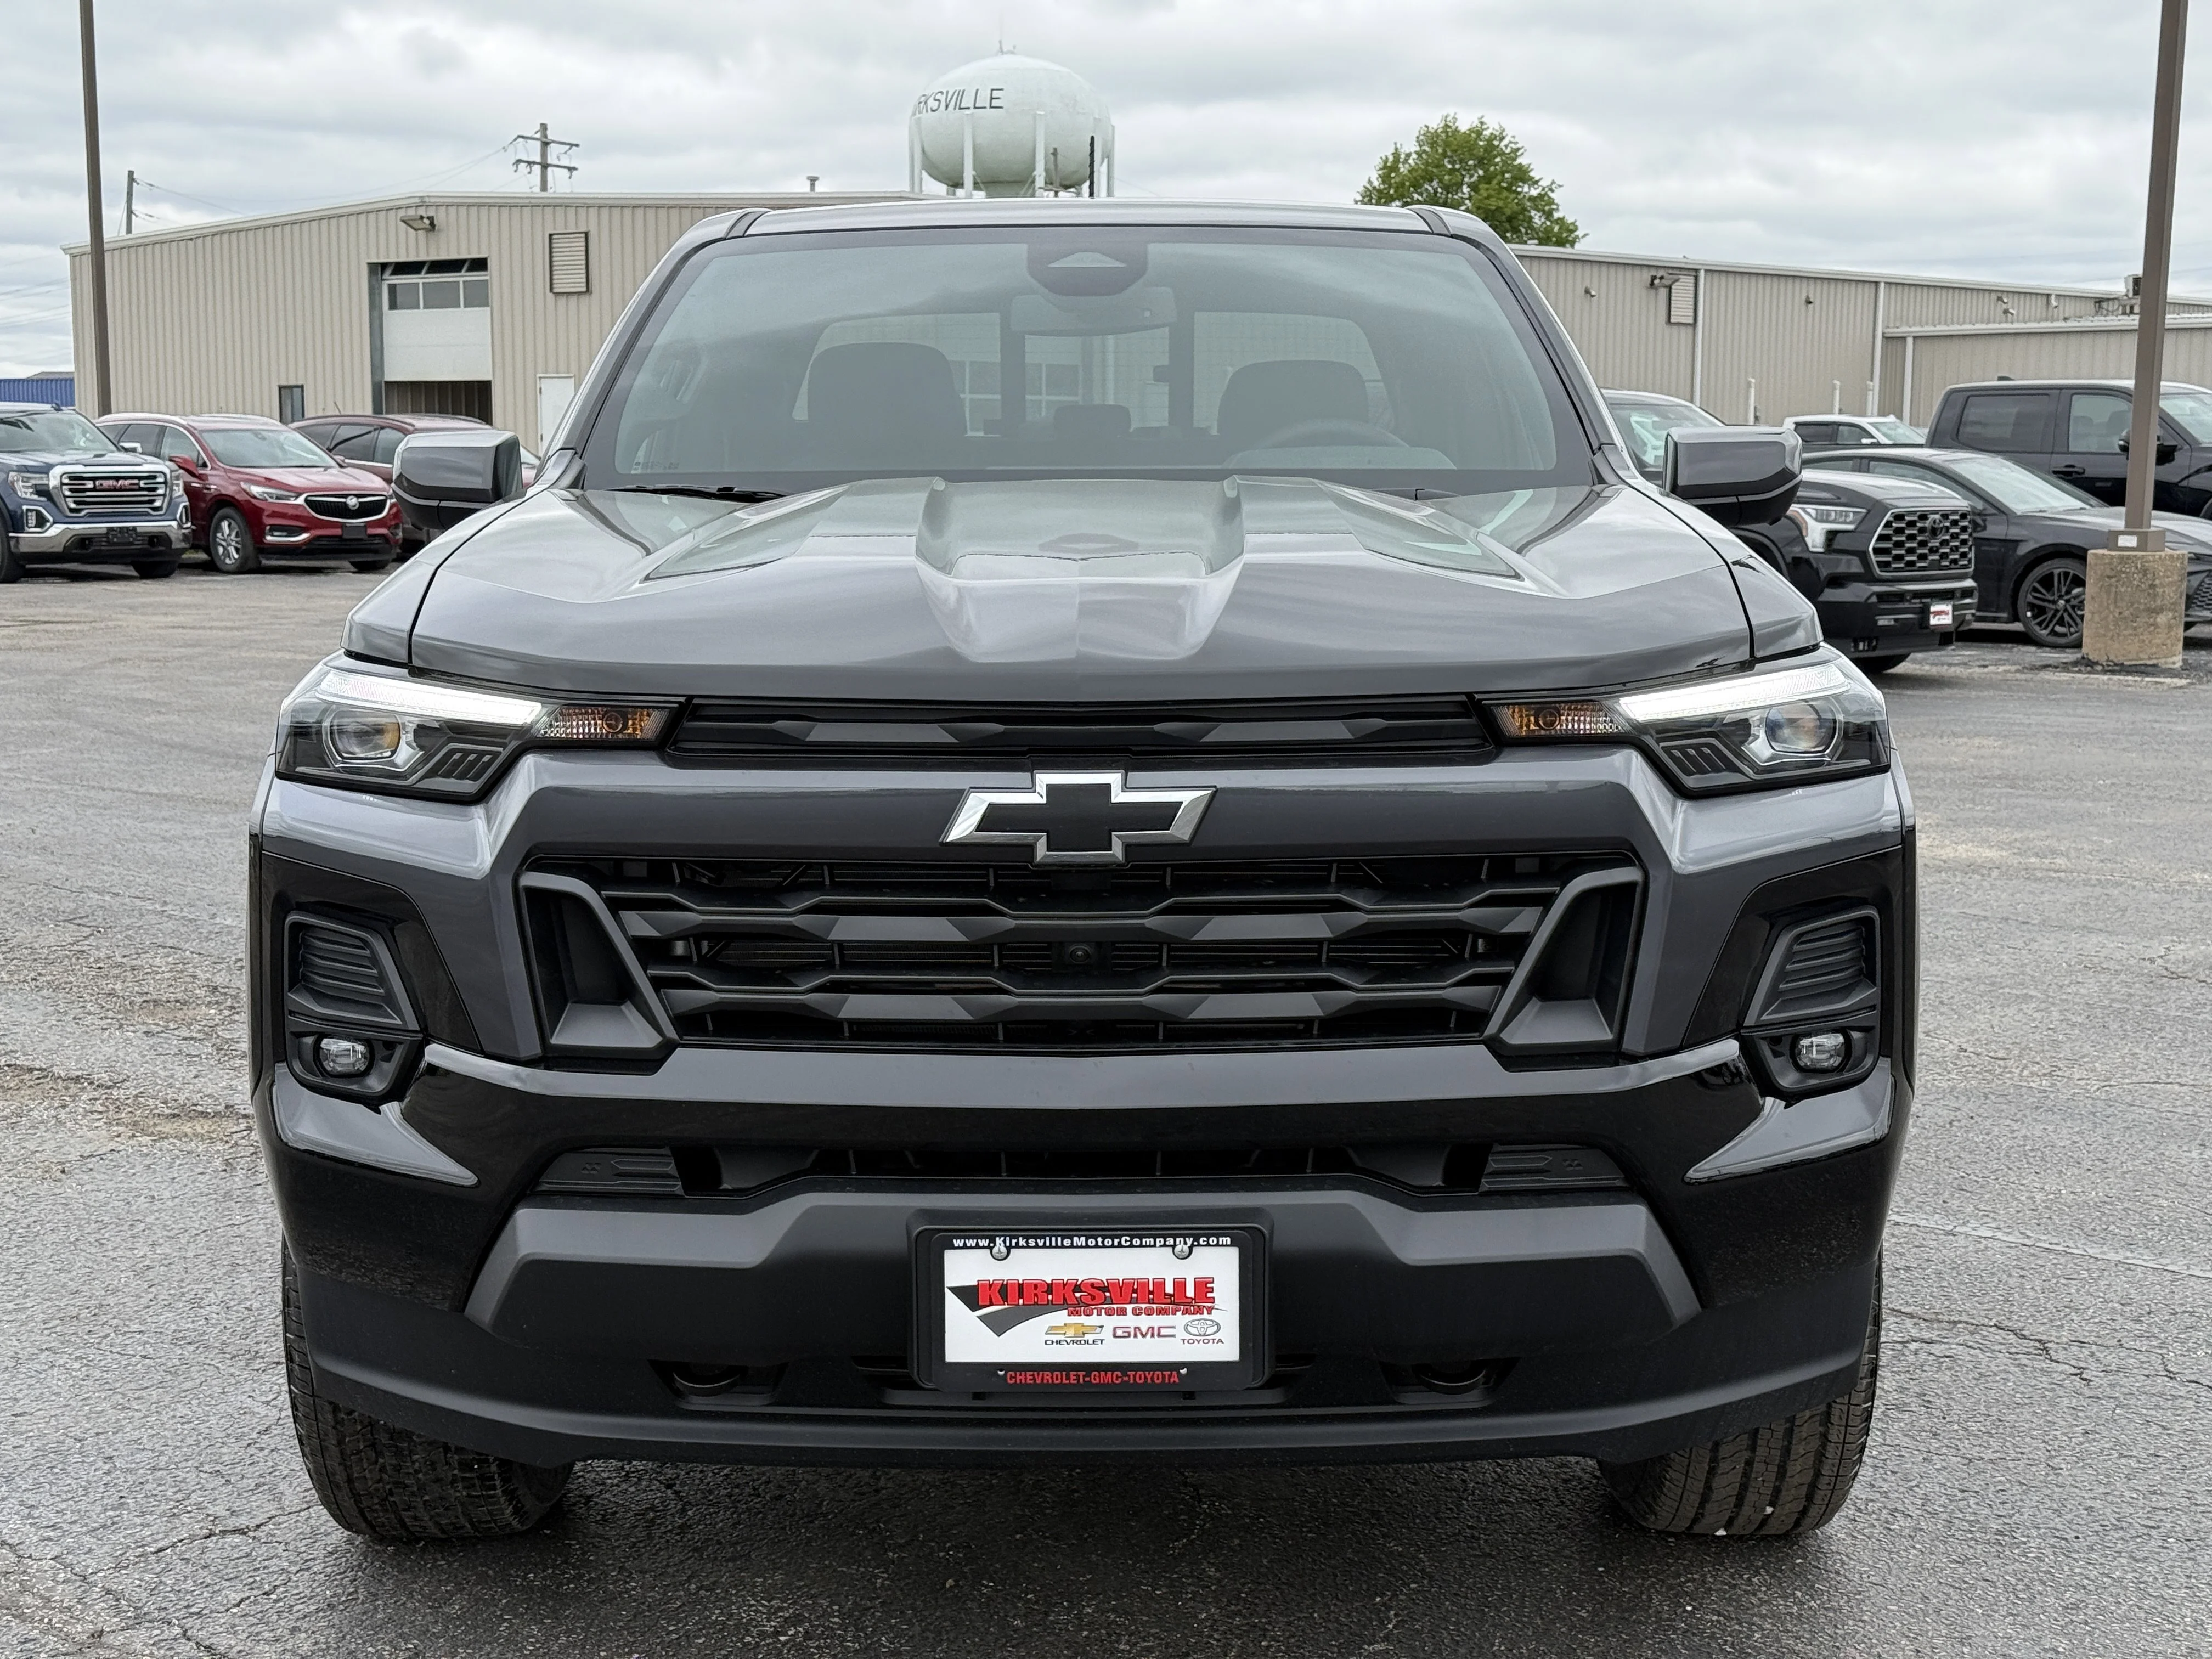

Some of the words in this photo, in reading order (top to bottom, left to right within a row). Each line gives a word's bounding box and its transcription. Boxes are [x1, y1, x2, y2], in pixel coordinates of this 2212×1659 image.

[95, 479, 139, 490] GMC
[952, 1236, 1231, 1248] www.KirksvilleMotorCompany.com
[977, 1278, 1215, 1306] KIRKSVILLE
[1067, 1306, 1127, 1317] MOTOR
[1132, 1305, 1215, 1316] COMPANY
[1112, 1325, 1177, 1339] GMC
[1007, 1370, 1180, 1384] CHEVROLET-GMC-TOYOTA
